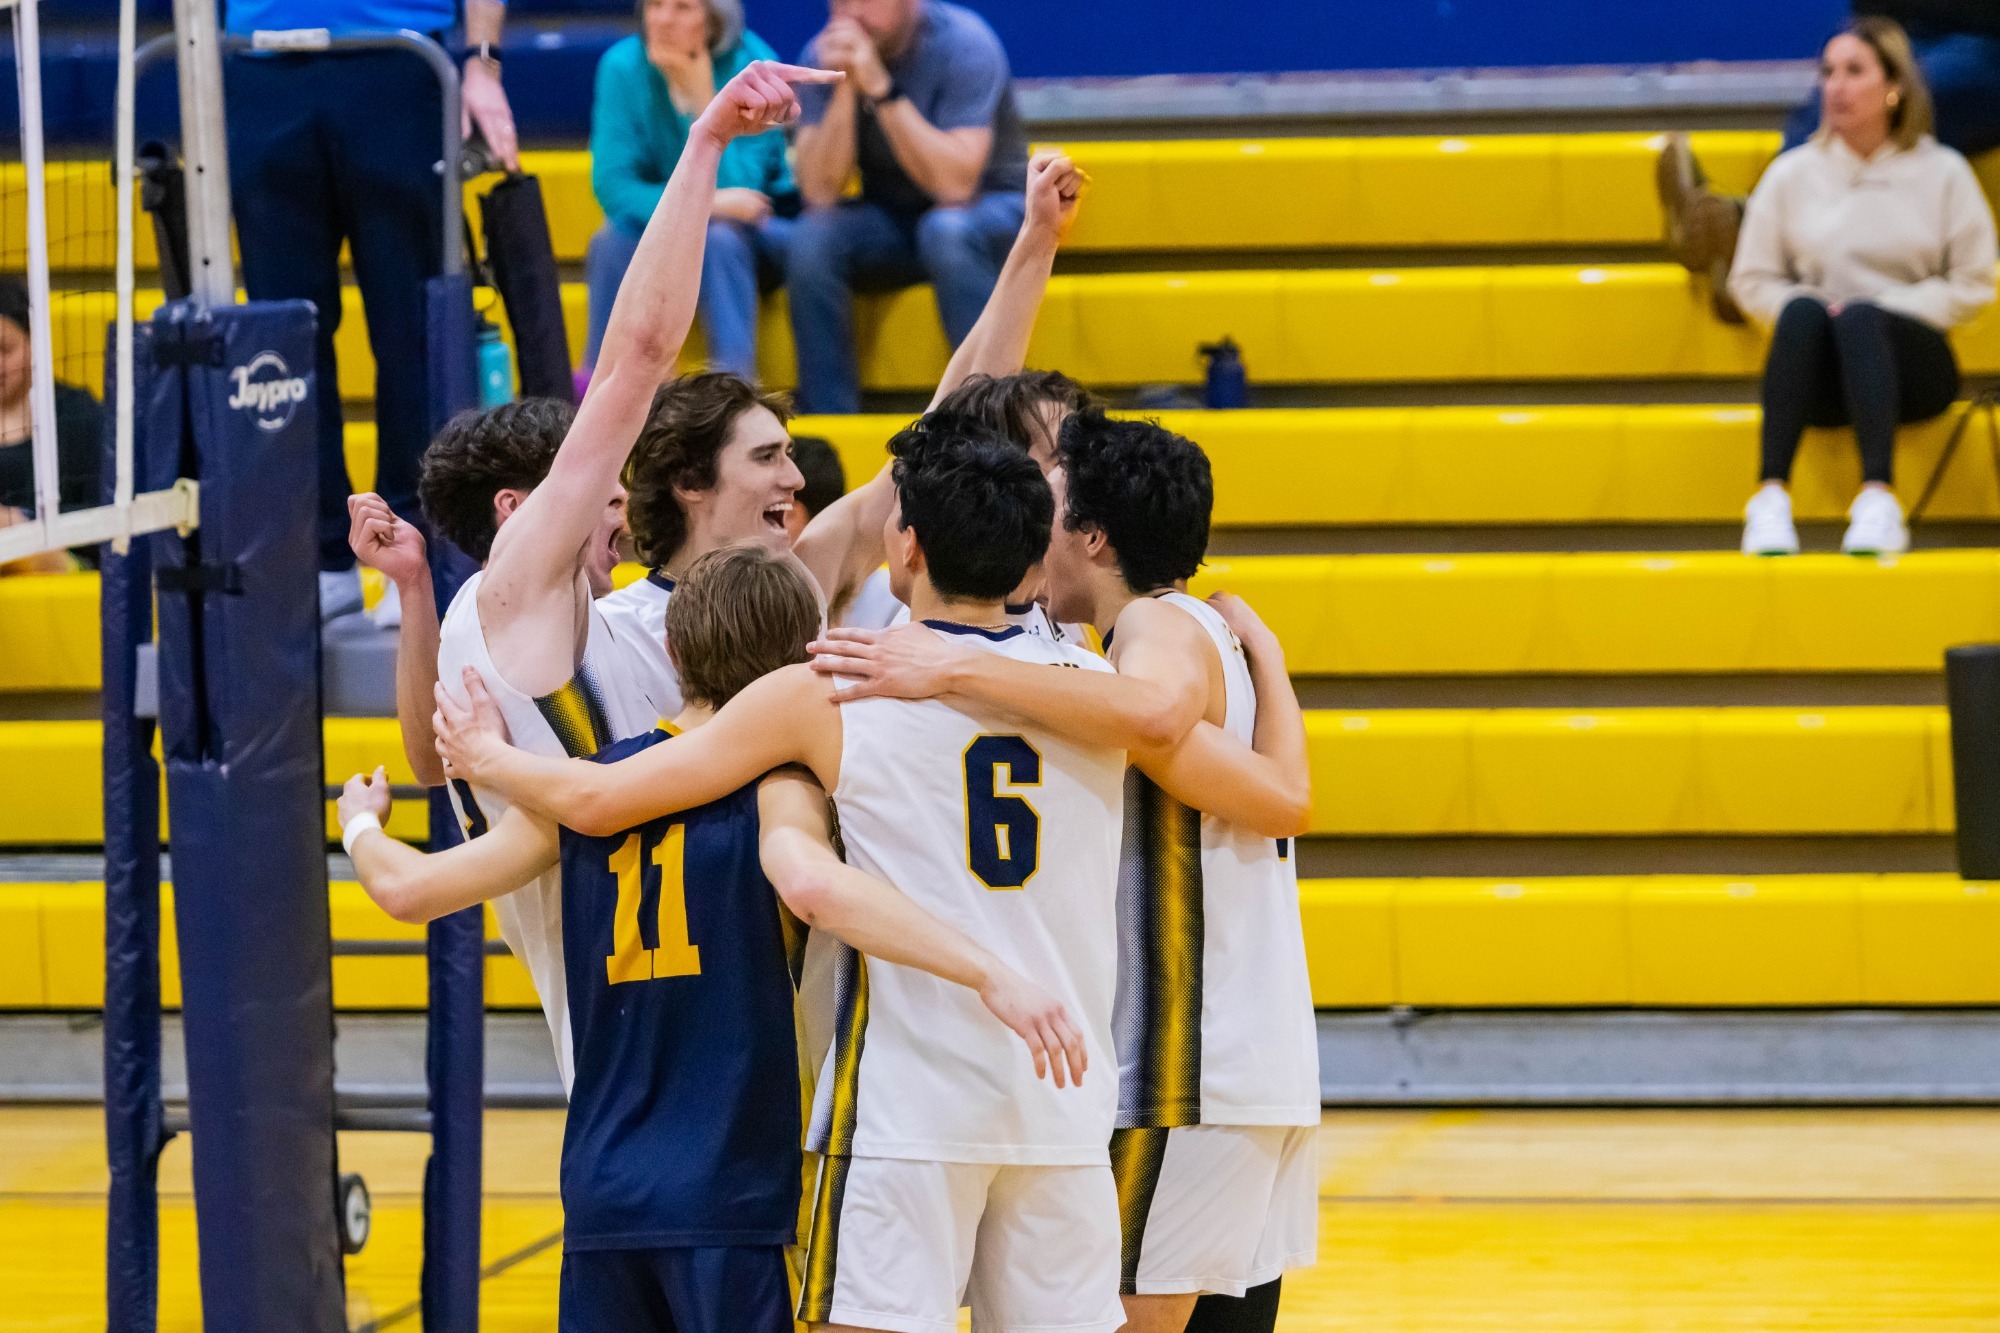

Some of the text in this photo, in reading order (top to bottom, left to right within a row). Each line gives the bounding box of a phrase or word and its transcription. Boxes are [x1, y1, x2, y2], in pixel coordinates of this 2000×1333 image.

[229, 366, 307, 413] Jaypro
[961, 733, 1043, 890] 6
[606, 823, 701, 985] 11
